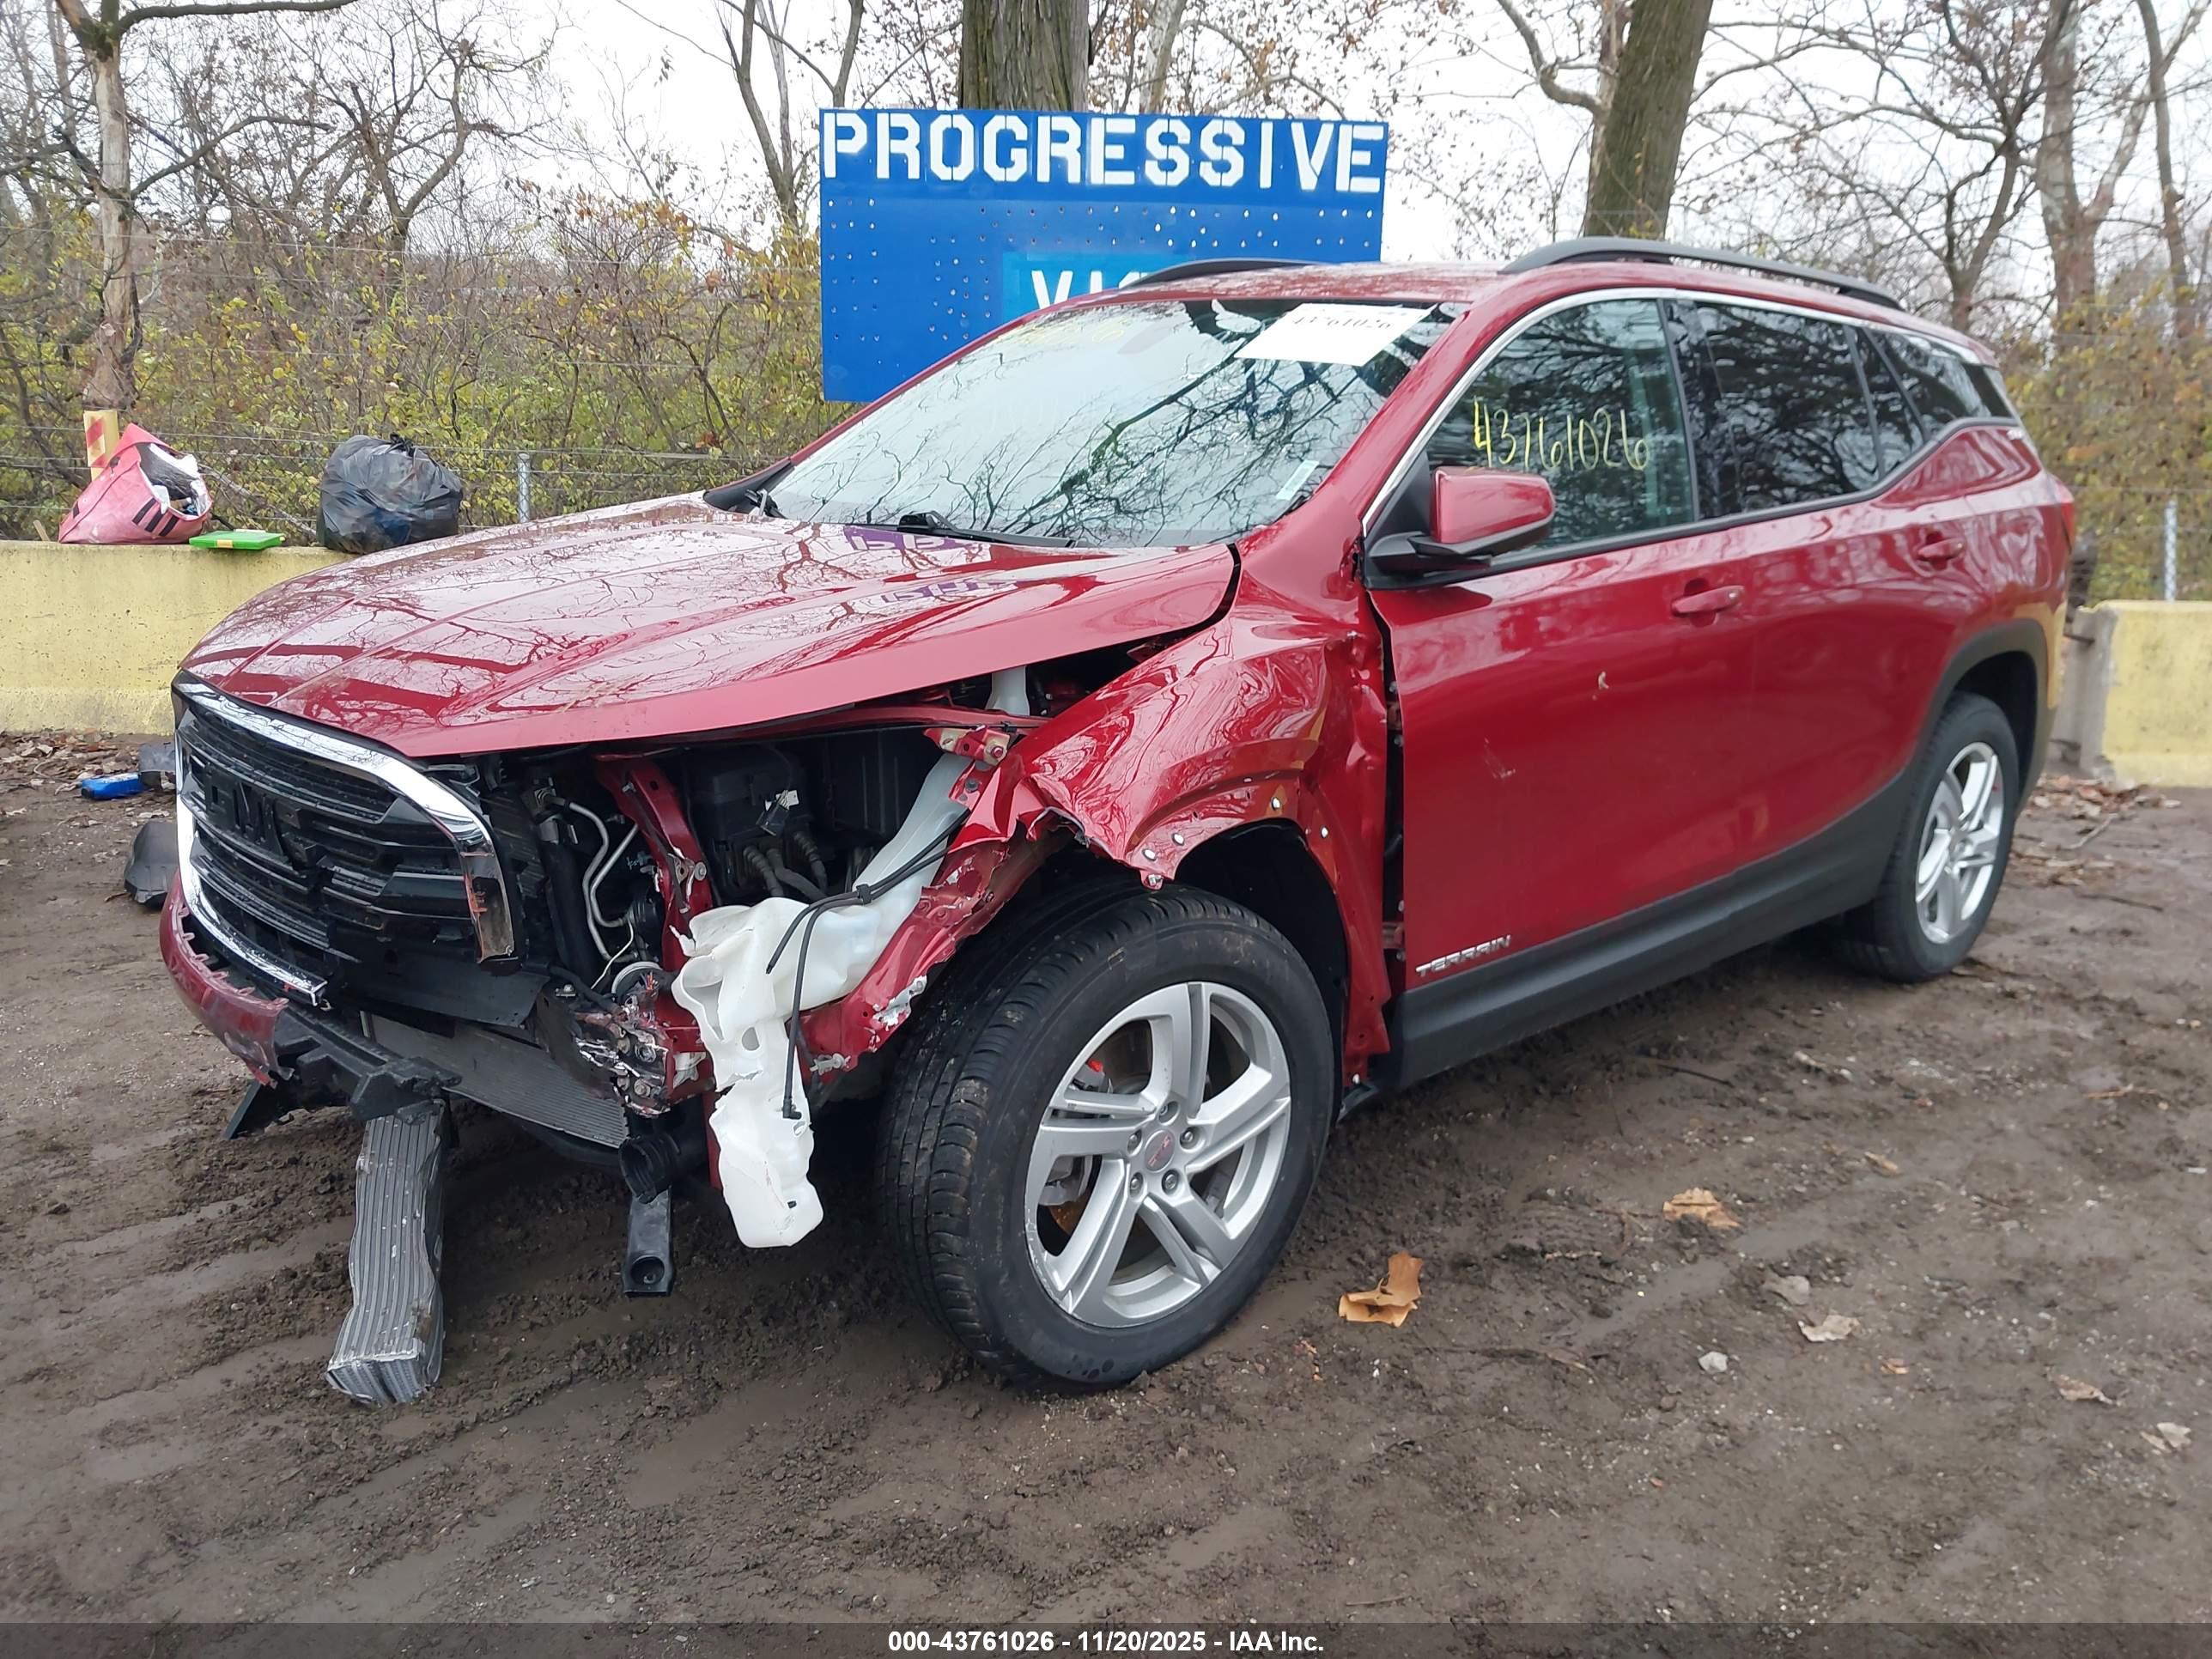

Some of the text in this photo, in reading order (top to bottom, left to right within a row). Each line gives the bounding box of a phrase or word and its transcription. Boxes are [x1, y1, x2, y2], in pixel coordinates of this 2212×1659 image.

[823, 112, 1385, 193] PROGRESSIVE
[1474, 396, 1650, 471] 43761026
[1415, 934, 1511, 977] TERRAIN
